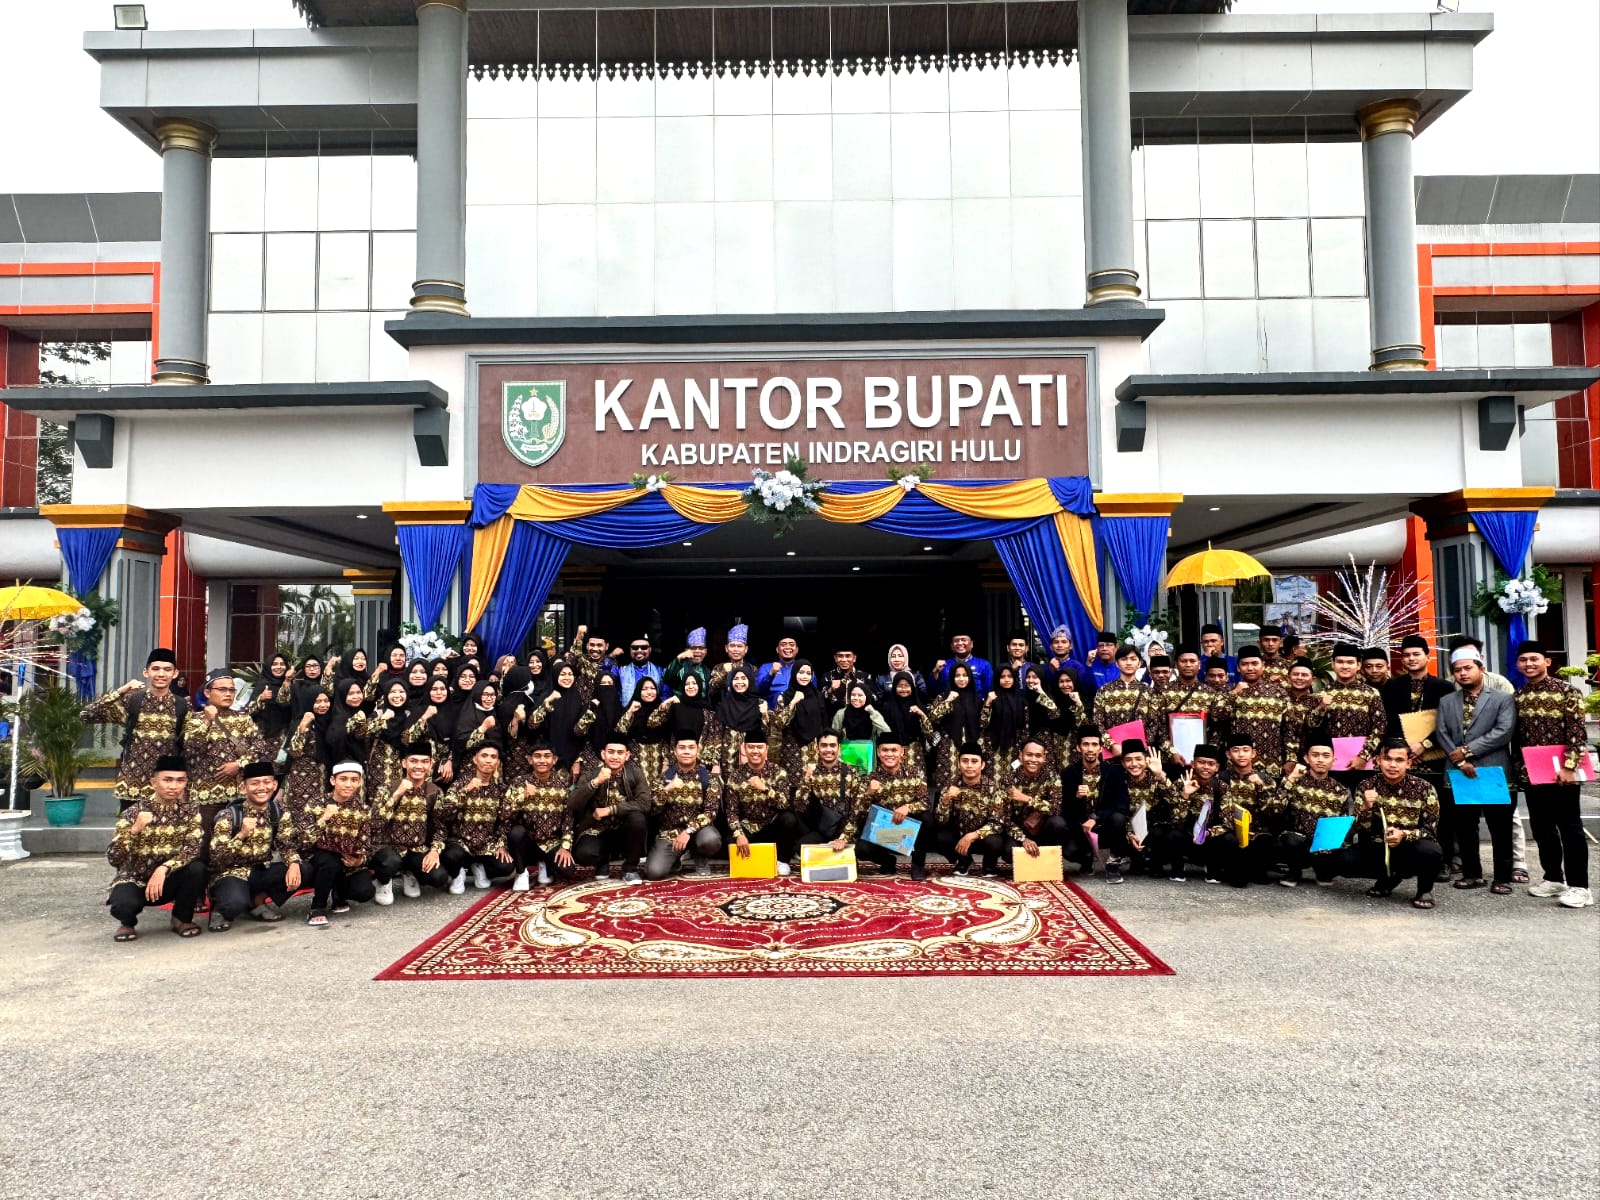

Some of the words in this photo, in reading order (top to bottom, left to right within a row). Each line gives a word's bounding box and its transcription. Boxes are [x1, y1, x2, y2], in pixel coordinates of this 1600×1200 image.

[593, 376, 847, 432] KANTOR
[863, 374, 1069, 430] BUPATI
[641, 441, 801, 466] KABUPATEN
[808, 440, 944, 465] INDRAGIRI
[950, 438, 1022, 463] HULU
